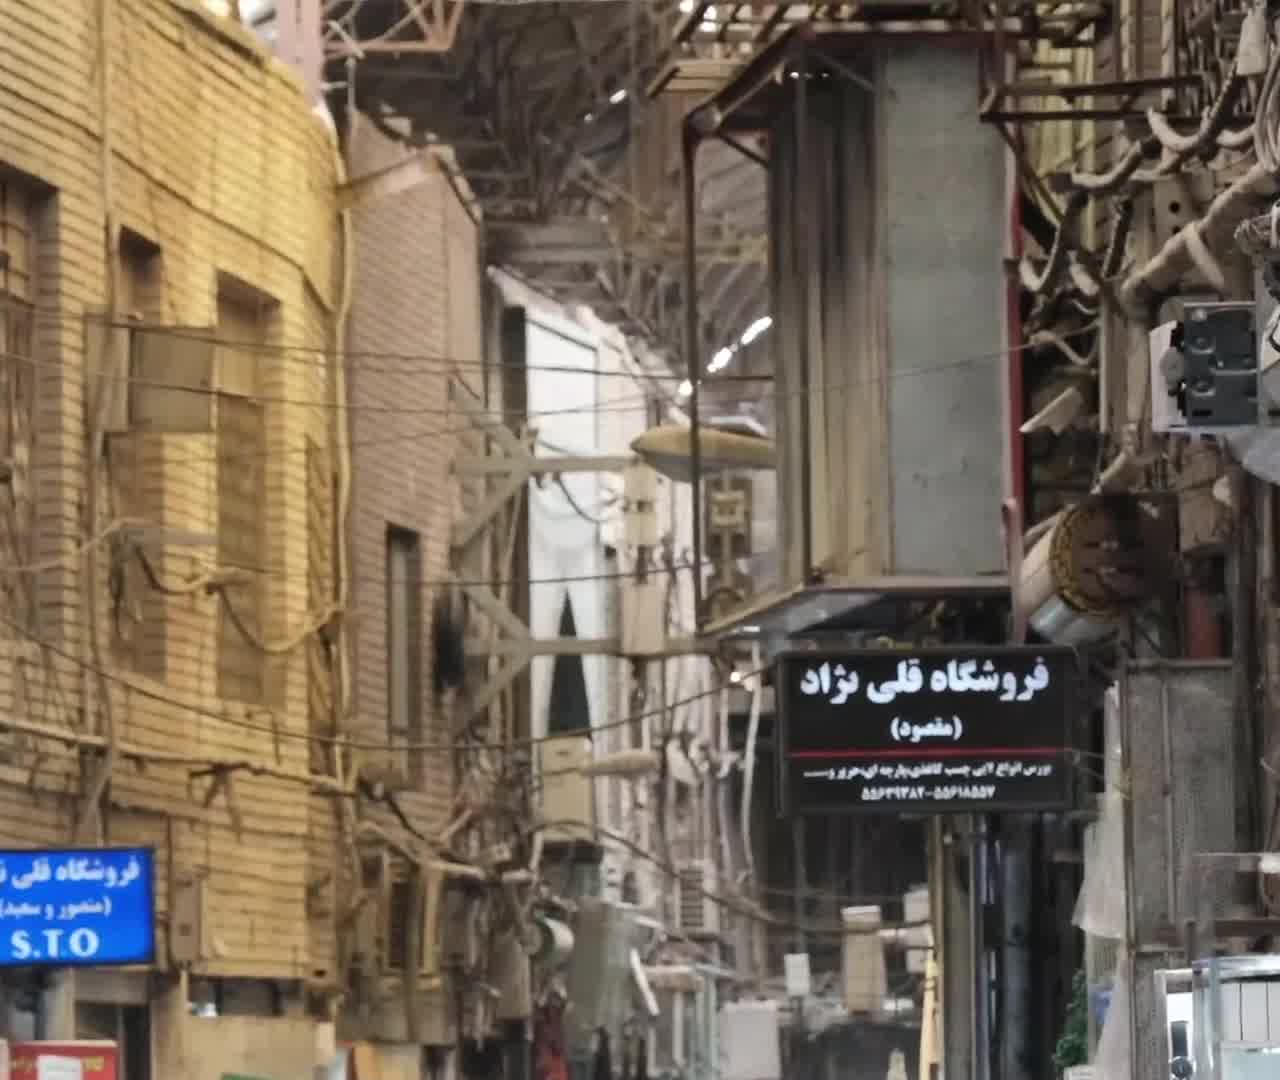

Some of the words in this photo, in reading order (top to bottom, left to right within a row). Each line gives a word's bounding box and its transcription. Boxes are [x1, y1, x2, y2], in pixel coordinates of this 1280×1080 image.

[799, 661, 859, 704] نژاد
[866, 658, 923, 704] قلی
[929, 656, 1050, 702] فروشگاه
[890, 715, 963, 742] (مقصود)
[11, 857, 51, 890] قلی
[55, 855, 141, 888] فروشگاه
